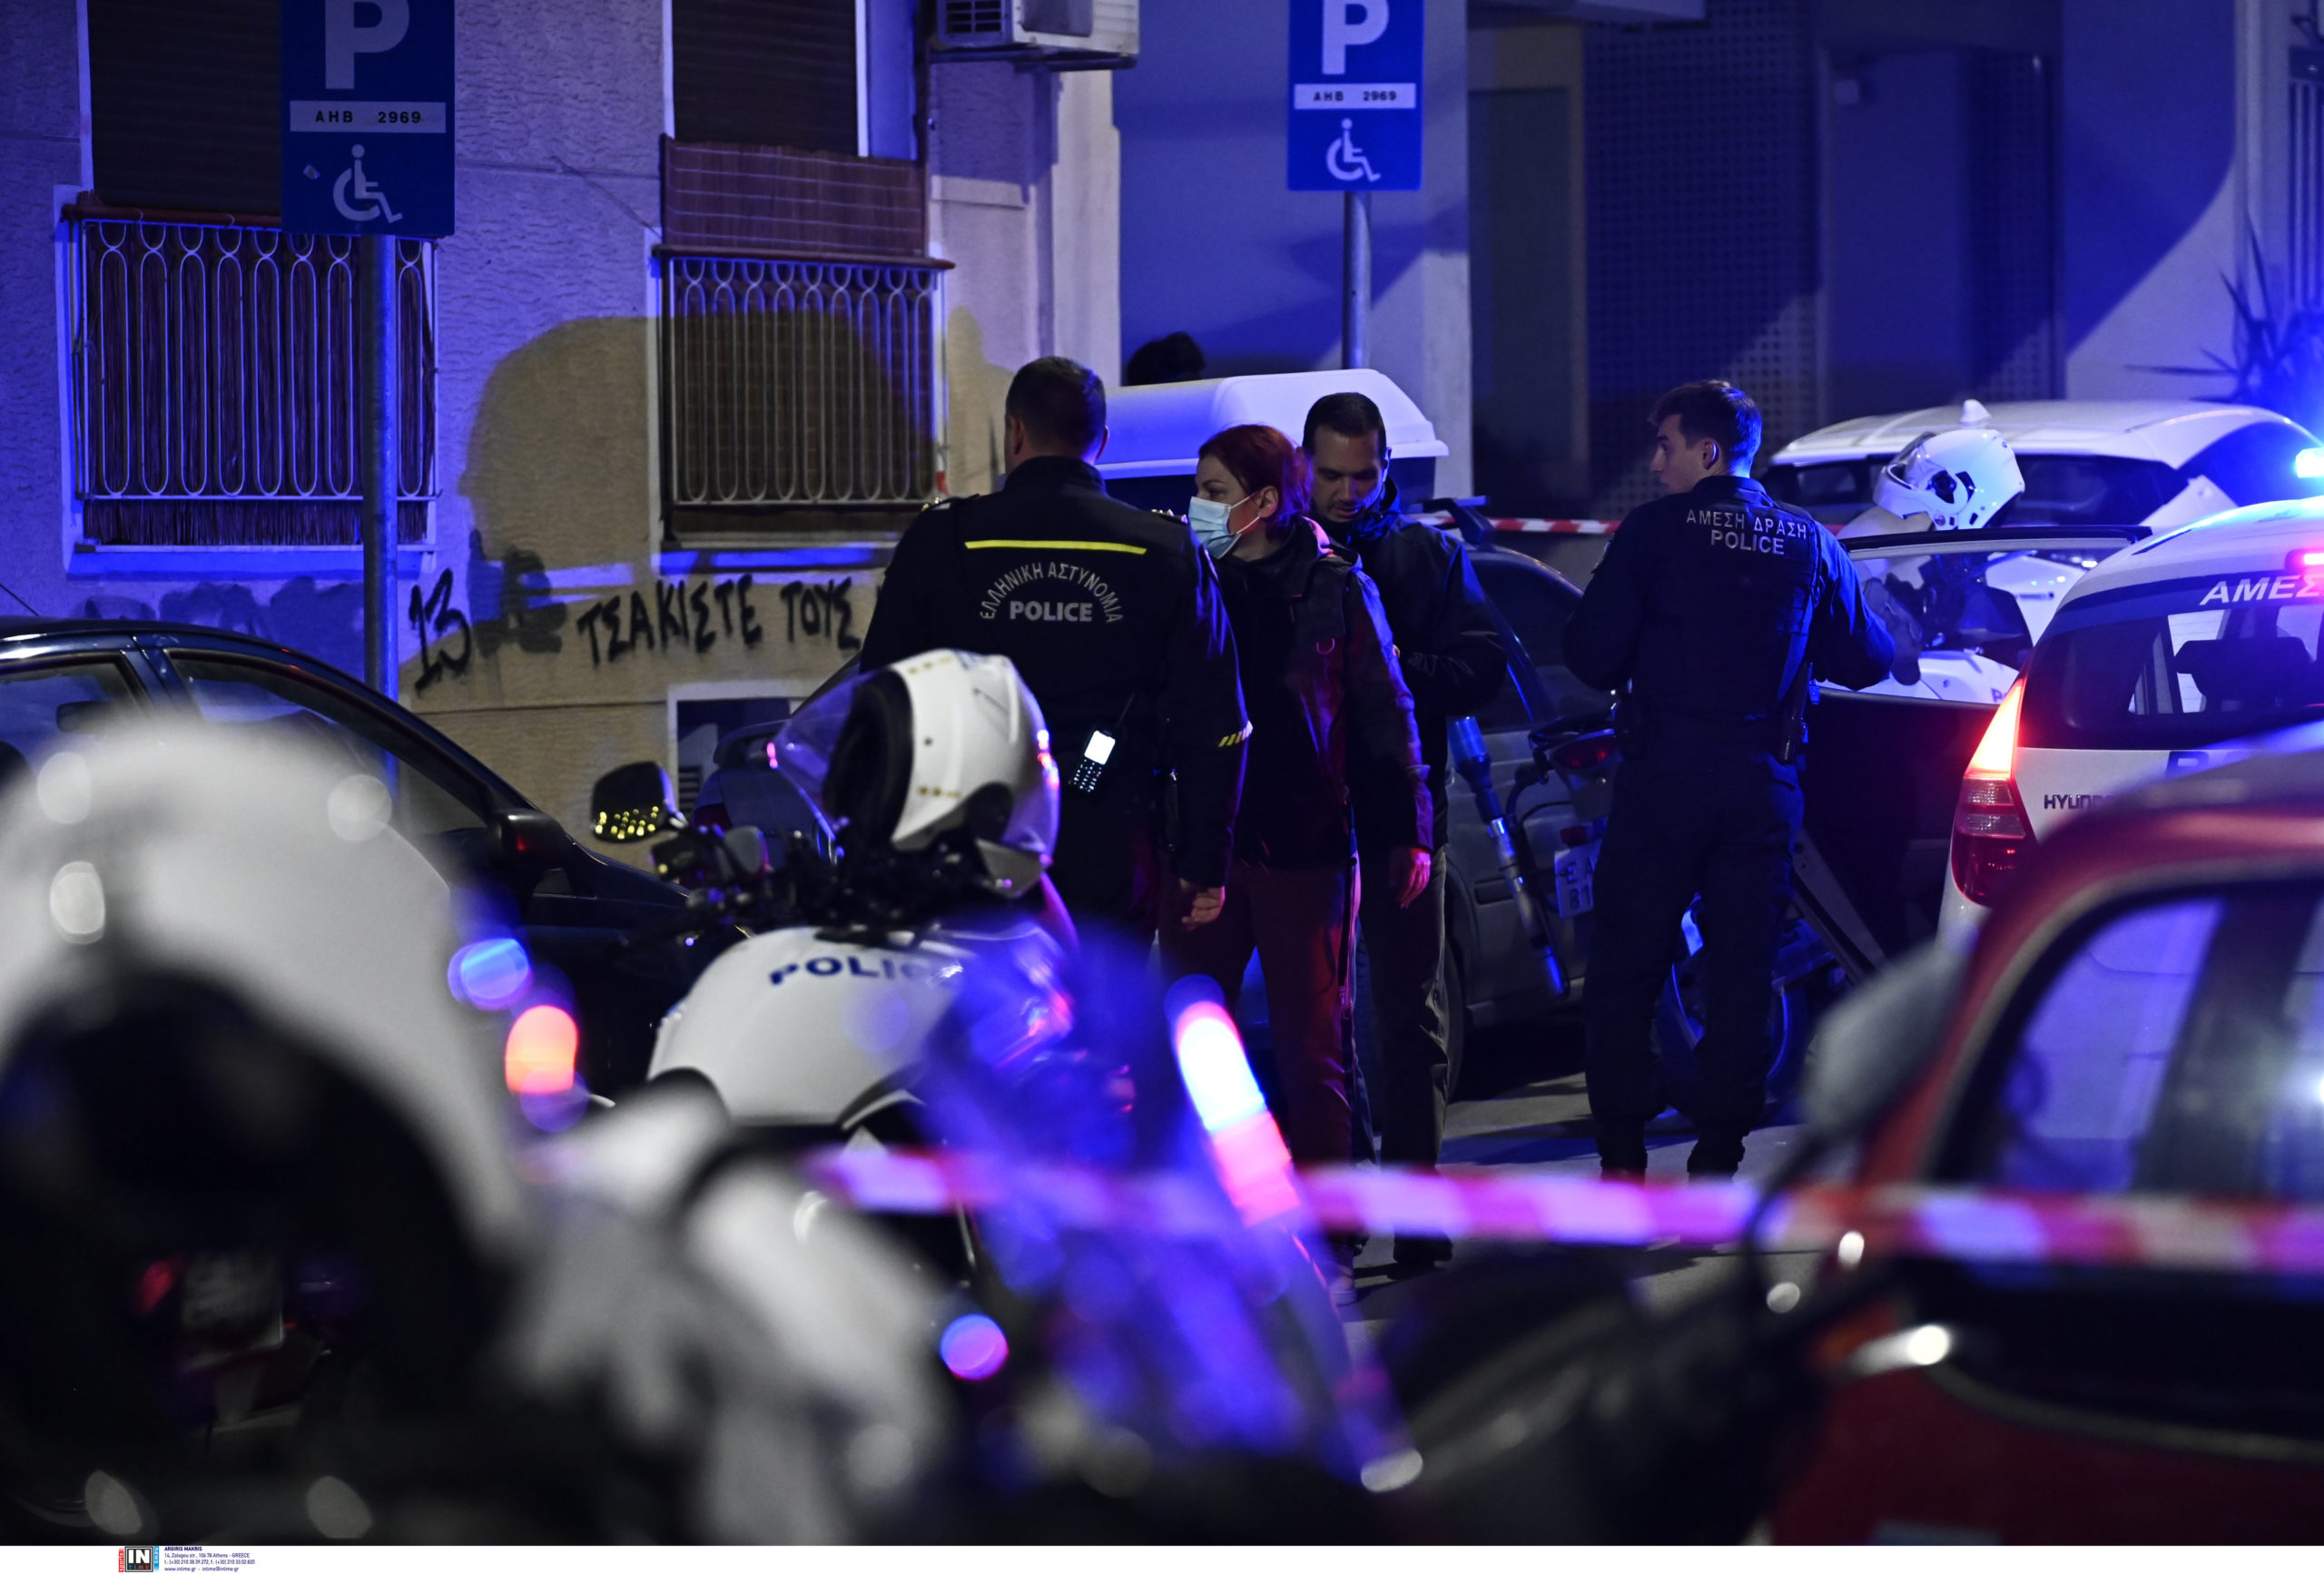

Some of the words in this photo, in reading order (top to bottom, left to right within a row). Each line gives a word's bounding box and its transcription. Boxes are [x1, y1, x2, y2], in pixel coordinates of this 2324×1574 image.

[325, 0, 410, 90] P
[1322, 0, 1390, 74] P
[1364, 91, 1397, 102] 2969
[315, 111, 353, 123] AHB
[378, 111, 422, 123] 2969
[1686, 509, 1745, 529] ΑΜΕΣΗ
[1753, 516, 1807, 540] ΔΡΑΣΗ
[1710, 529, 1785, 556] POLICE
[980, 562, 1044, 620] ΕΛΛΗΝΙΚΗ
[1048, 561, 1124, 623] ΑΣΤΥΝΟΜΙΑ
[2199, 574, 2324, 606] ΑΜΕΣ
[1009, 600, 1093, 623] POLICE
